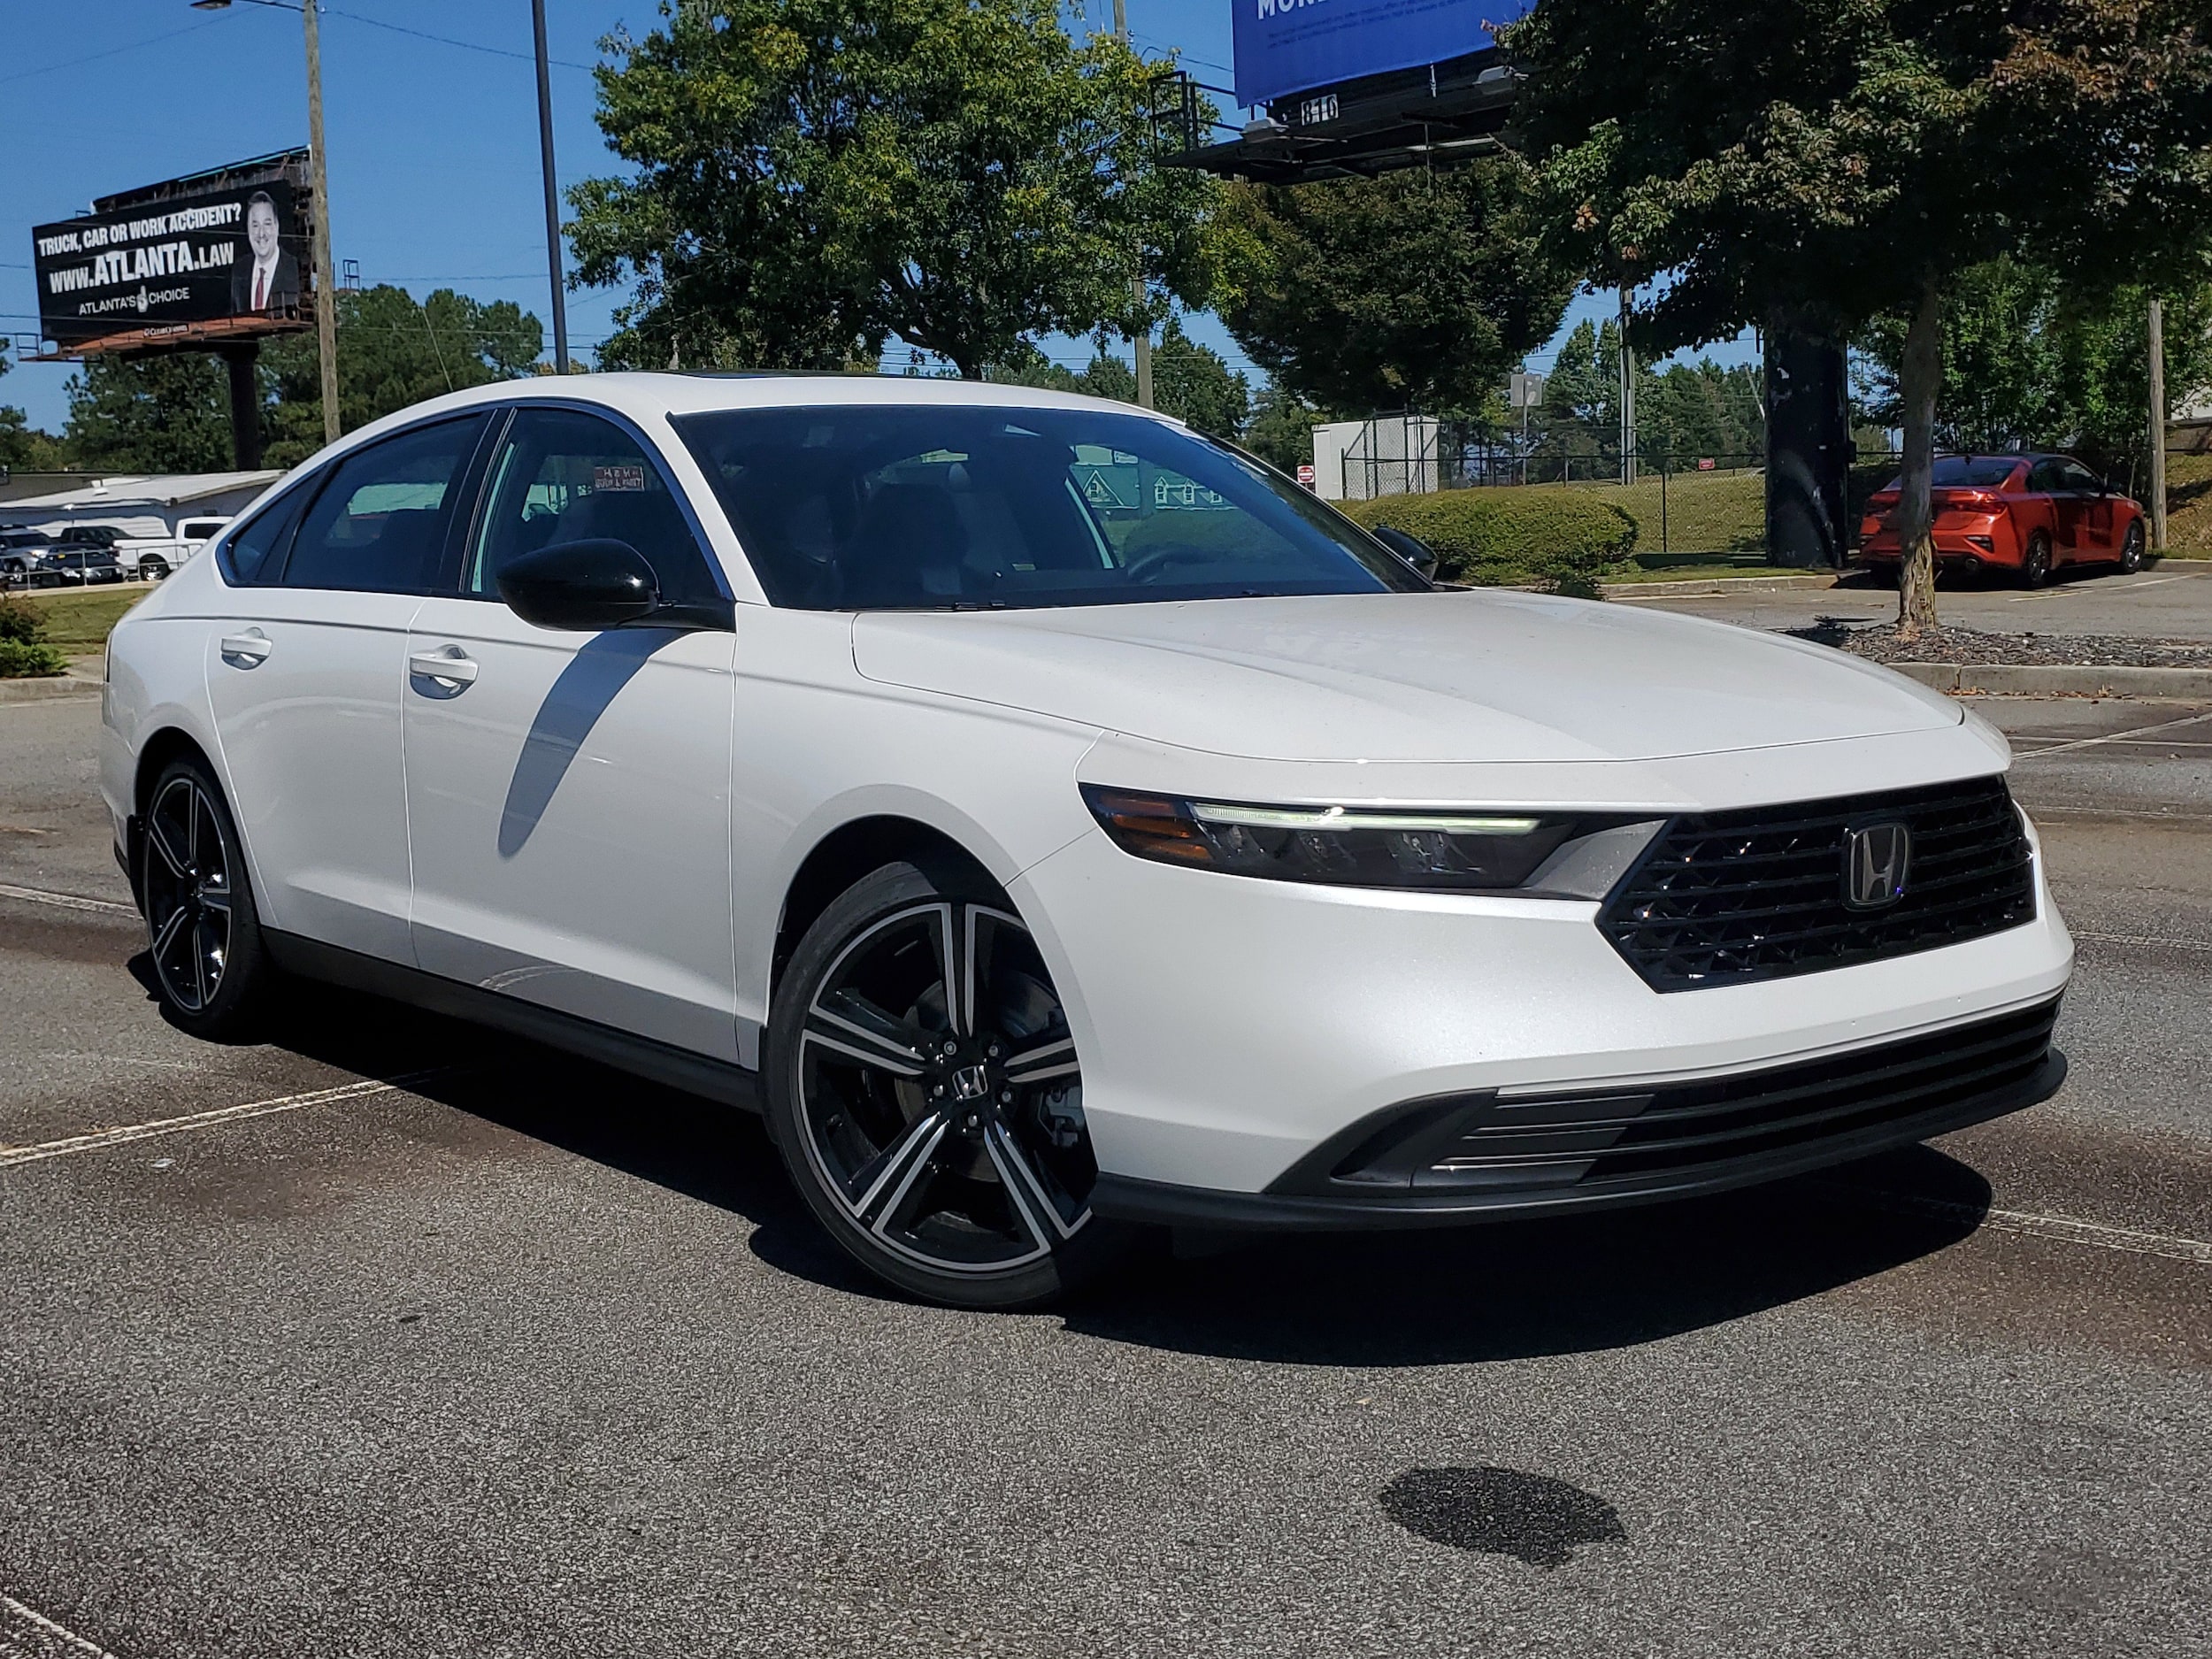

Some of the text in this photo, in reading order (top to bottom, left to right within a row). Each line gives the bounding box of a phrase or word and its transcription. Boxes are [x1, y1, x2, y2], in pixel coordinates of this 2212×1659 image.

[1302, 96, 1337, 125] 810
[38, 203, 242, 257] TRUCK, CAR OR WORK ACCIDENT?
[79, 288, 190, 316] ATLANTA'S CHOICE
